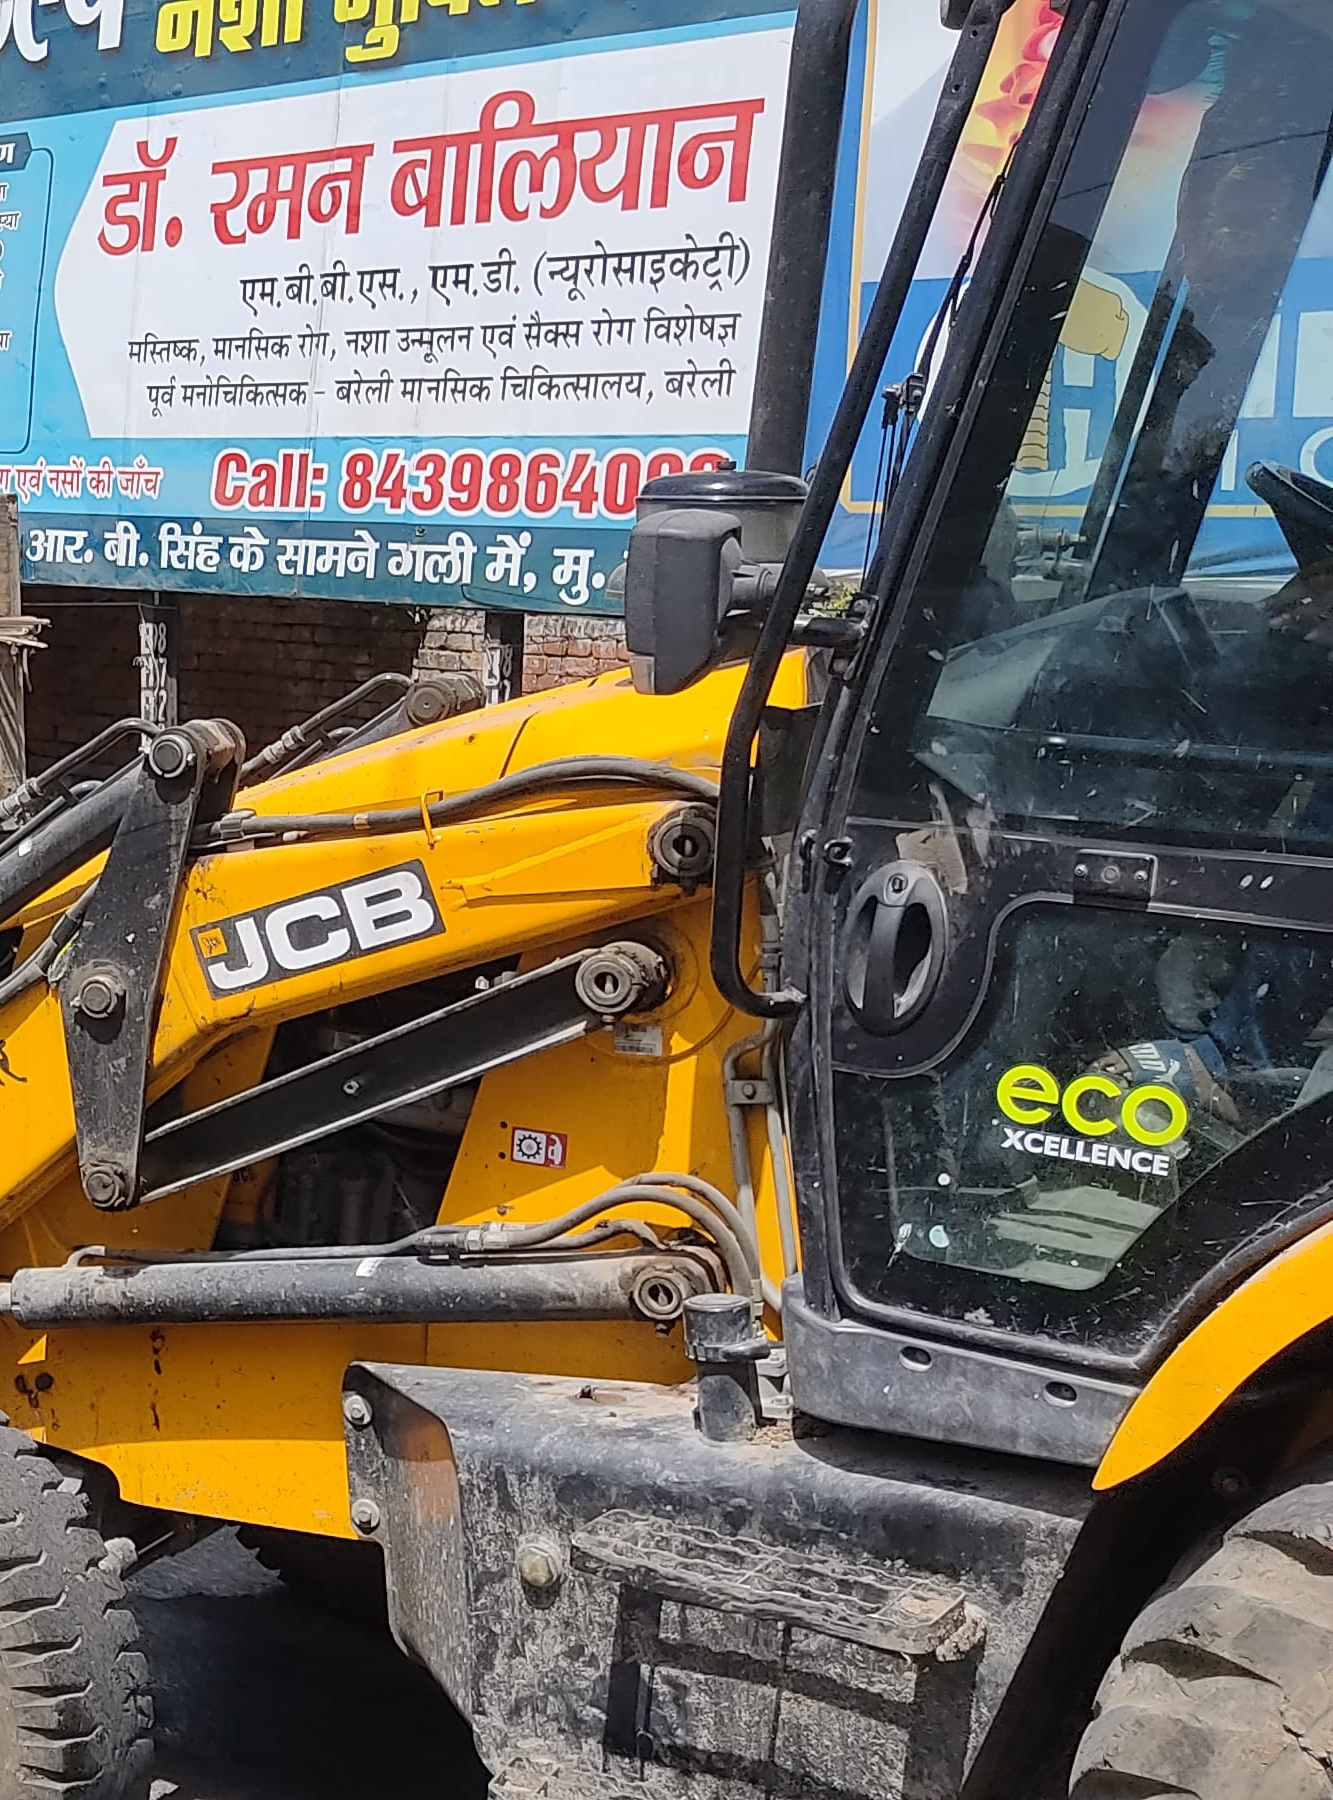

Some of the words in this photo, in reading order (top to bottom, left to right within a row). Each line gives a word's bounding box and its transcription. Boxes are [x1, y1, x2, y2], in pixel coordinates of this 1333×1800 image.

[98, 138, 183, 257] डॉ.
[211, 144, 374, 245] रमन
[391, 90, 765, 228] बालियान
[428, 248, 520, 305] एम.डी.
[534, 231, 751, 300] (न्यूरोसाइकेट्री)
[128, 333, 206, 366] मस्तिष्क,
[213, 328, 293, 360] मानसिक
[298, 324, 336, 361] रोग,
[344, 330, 390, 358] नशा
[397, 327, 474, 363] उन्मूलन
[481, 315, 517, 358] एवं
[523, 311, 583, 349] सैक्स
[590, 308, 635, 346] रोग
[644, 304, 741, 347] विशेषज्ञ
[147, 376, 175, 417] पूर्व
[182, 374, 309, 408] मनोचिकित्सक
[335, 369, 393, 404] बरेली
[400, 368, 493, 403] मानसिक
[501, 365, 653, 404] चिकित्सालय,
[664, 358, 736, 398] बरेली
[15, 458, 45, 502] एवं
[48, 457, 84, 496] नसों
[88, 458, 114, 497] की
[118, 457, 162, 497] जाँच
[215, 452, 325, 508] Call:
[342, 453, 729, 516] 84398640
[26, 529, 93, 564] आर.
[104, 522, 149, 567] बी.
[158, 521, 222, 576] सिंह
[229, 528, 270, 575] के
[277, 531, 379, 580] सामने
[388, 533, 478, 584] गली
[486, 532, 538, 594] में,
[553, 549, 606, 604] मु.
[208, 871, 434, 990] JCB
[996, 1064, 1188, 1146] eco
[1000, 1127, 1170, 1177] XCELLENCE
